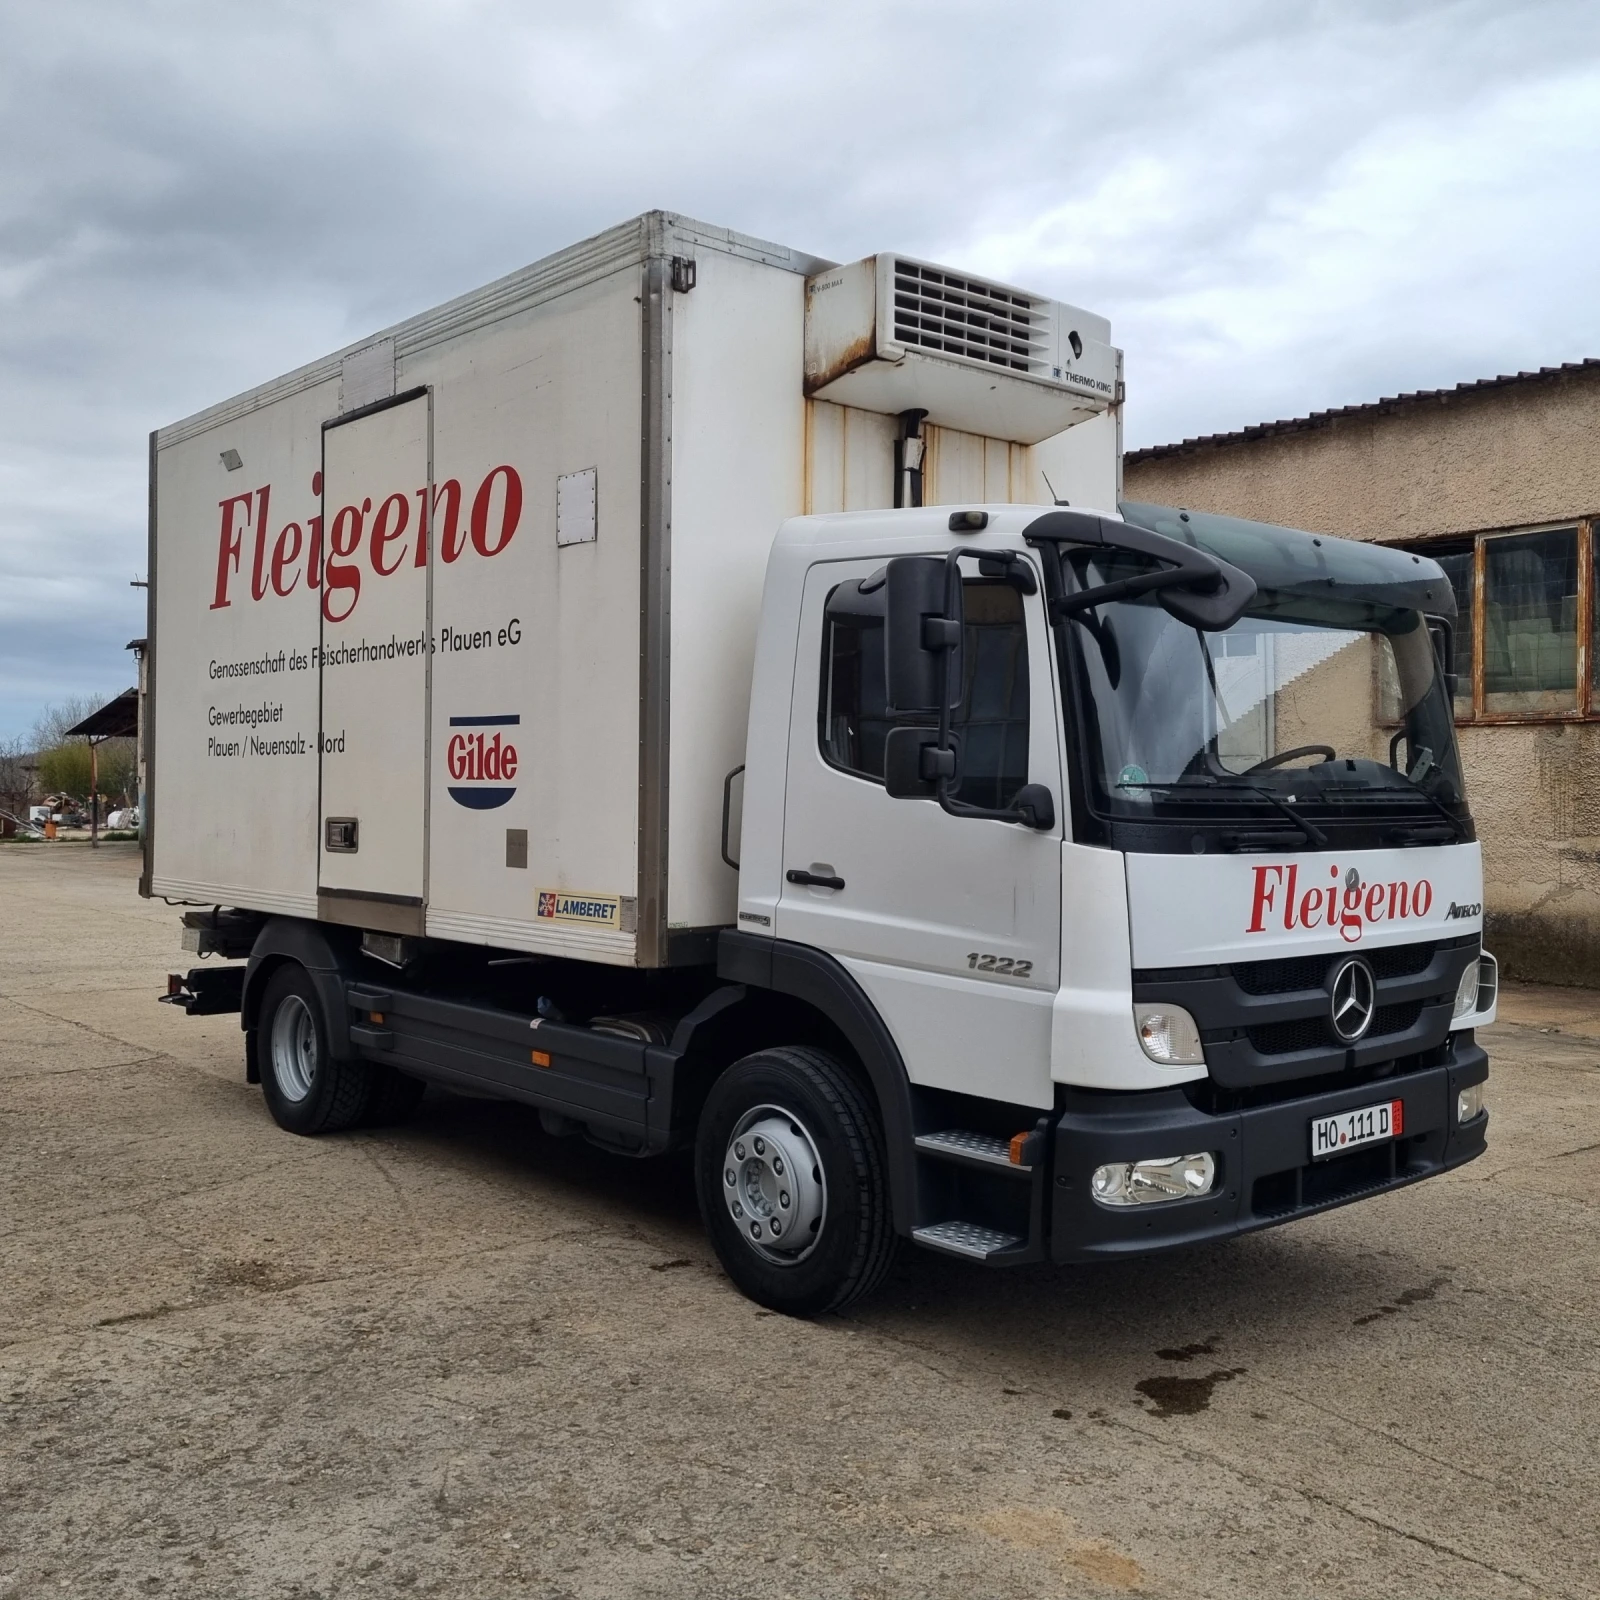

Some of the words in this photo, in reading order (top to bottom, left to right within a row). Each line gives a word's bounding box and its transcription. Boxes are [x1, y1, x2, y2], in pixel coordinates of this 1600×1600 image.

[1065, 371, 1095, 389] THERMO
[1096, 380, 1112, 394] KING
[209, 465, 523, 623] Fleigeno
[209, 650, 285, 680] Genossenschaft
[289, 648, 308, 671] des
[442, 626, 492, 653] Plauen
[498, 618, 522, 646] eG
[208, 701, 283, 729] Gewerbegebiet
[208, 736, 240, 757] Plauen
[242, 735, 248, 758] /
[250, 732, 306, 756] Neuensalz
[317, 729, 345, 754] Nord
[447, 732, 518, 781] Gilde
[555, 898, 617, 920] LAMBERET
[1246, 864, 1432, 943] Fleigeno
[967, 952, 1033, 978] 1222
[1317, 1119, 1338, 1150] HO
[1348, 1111, 1375, 1142] 111
[1379, 1107, 1389, 1134] D
